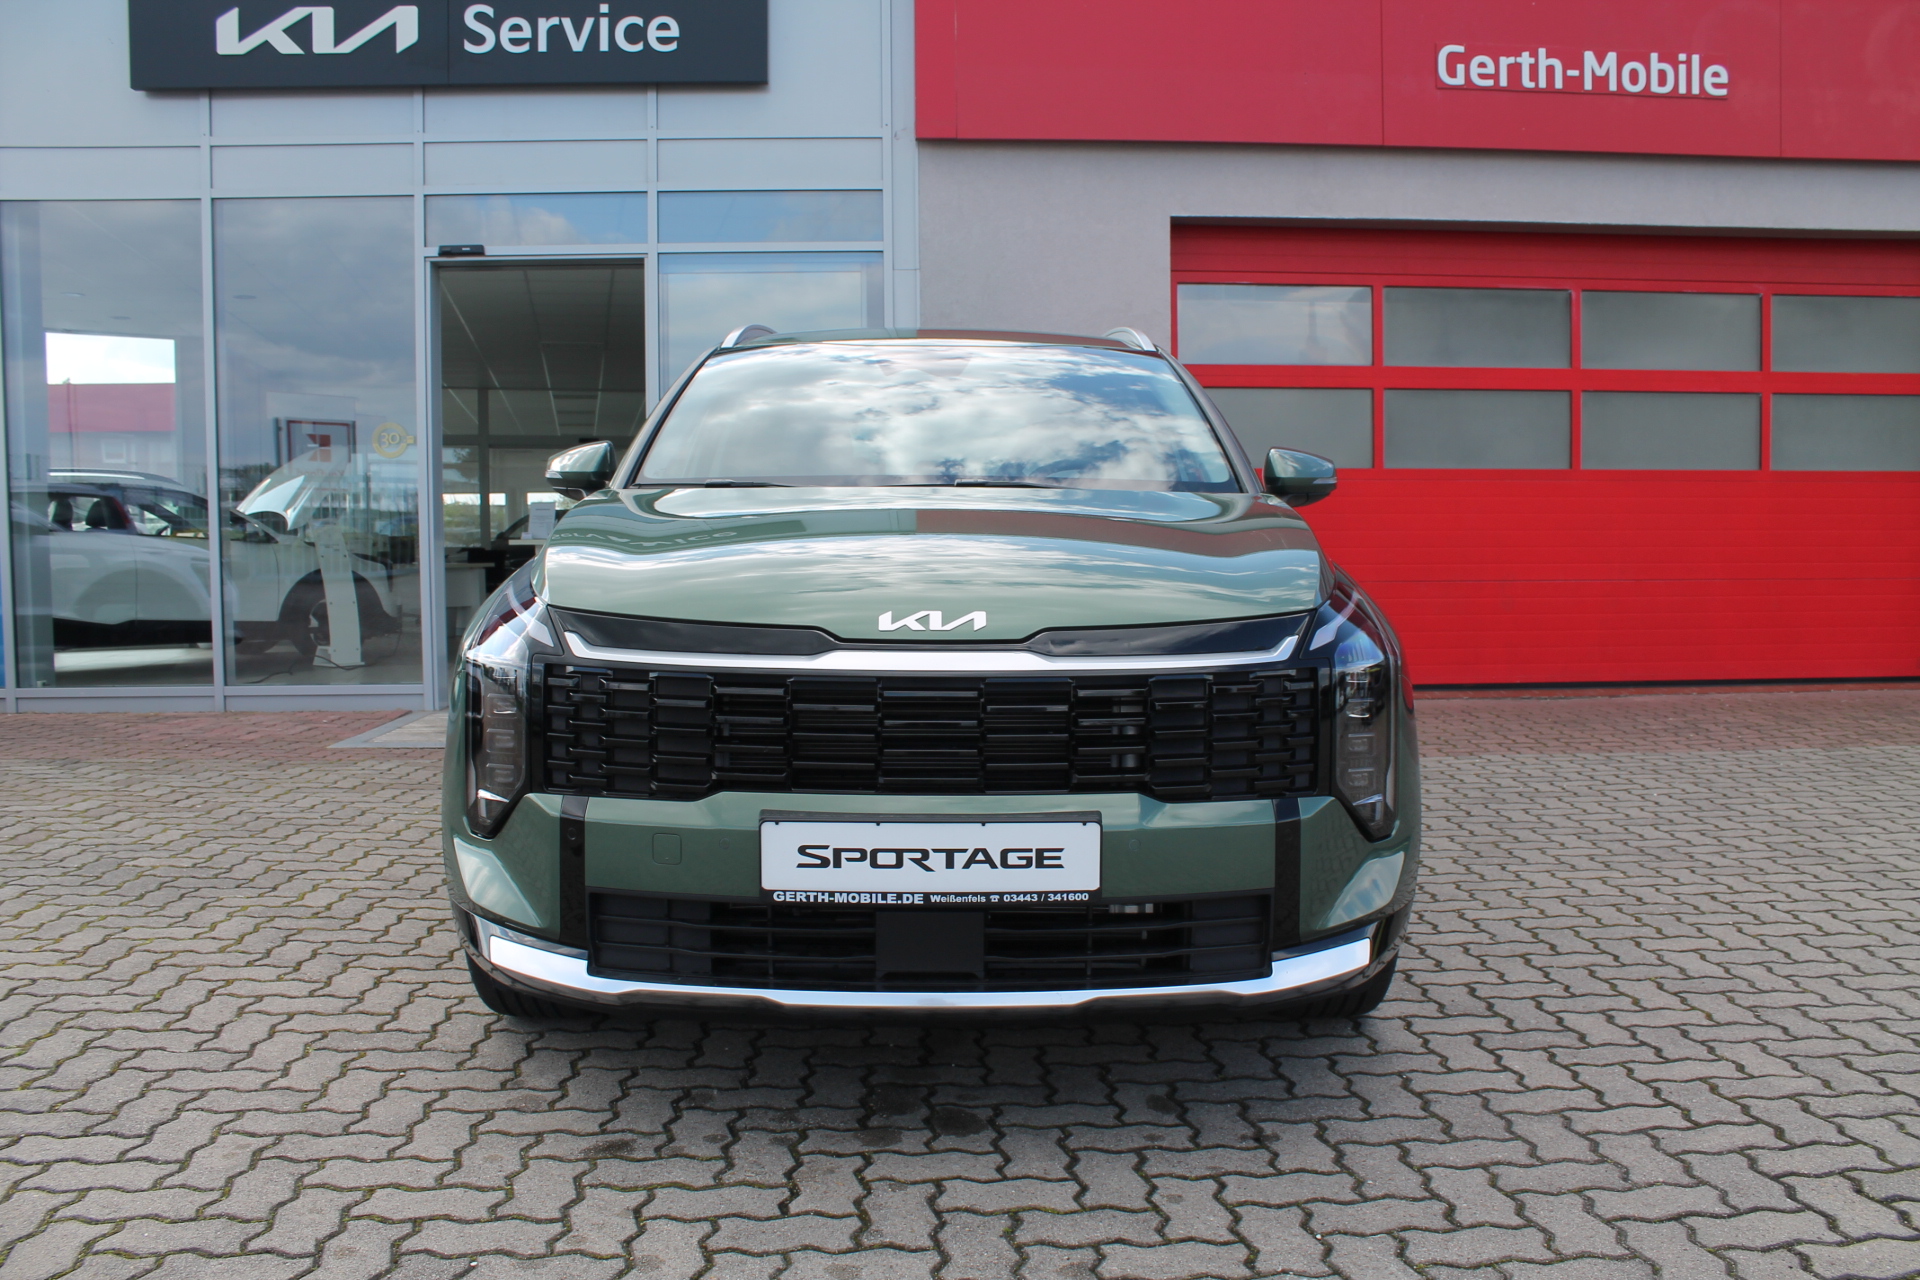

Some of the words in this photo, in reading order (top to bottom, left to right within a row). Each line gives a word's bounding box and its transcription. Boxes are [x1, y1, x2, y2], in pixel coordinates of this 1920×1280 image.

[216, 5, 418, 55] KIA
[463, 3, 680, 54] Service
[1437, 44, 1729, 96] Gerth-Mobile
[878, 610, 987, 632] KIA
[796, 844, 1065, 872] SPORTAGE
[773, 891, 924, 904] GERTH-MOBILE.DE
[930, 894, 986, 903] Weißenfels
[1003, 893, 1038, 902] 03443
[1047, 892, 1089, 901] 341600
